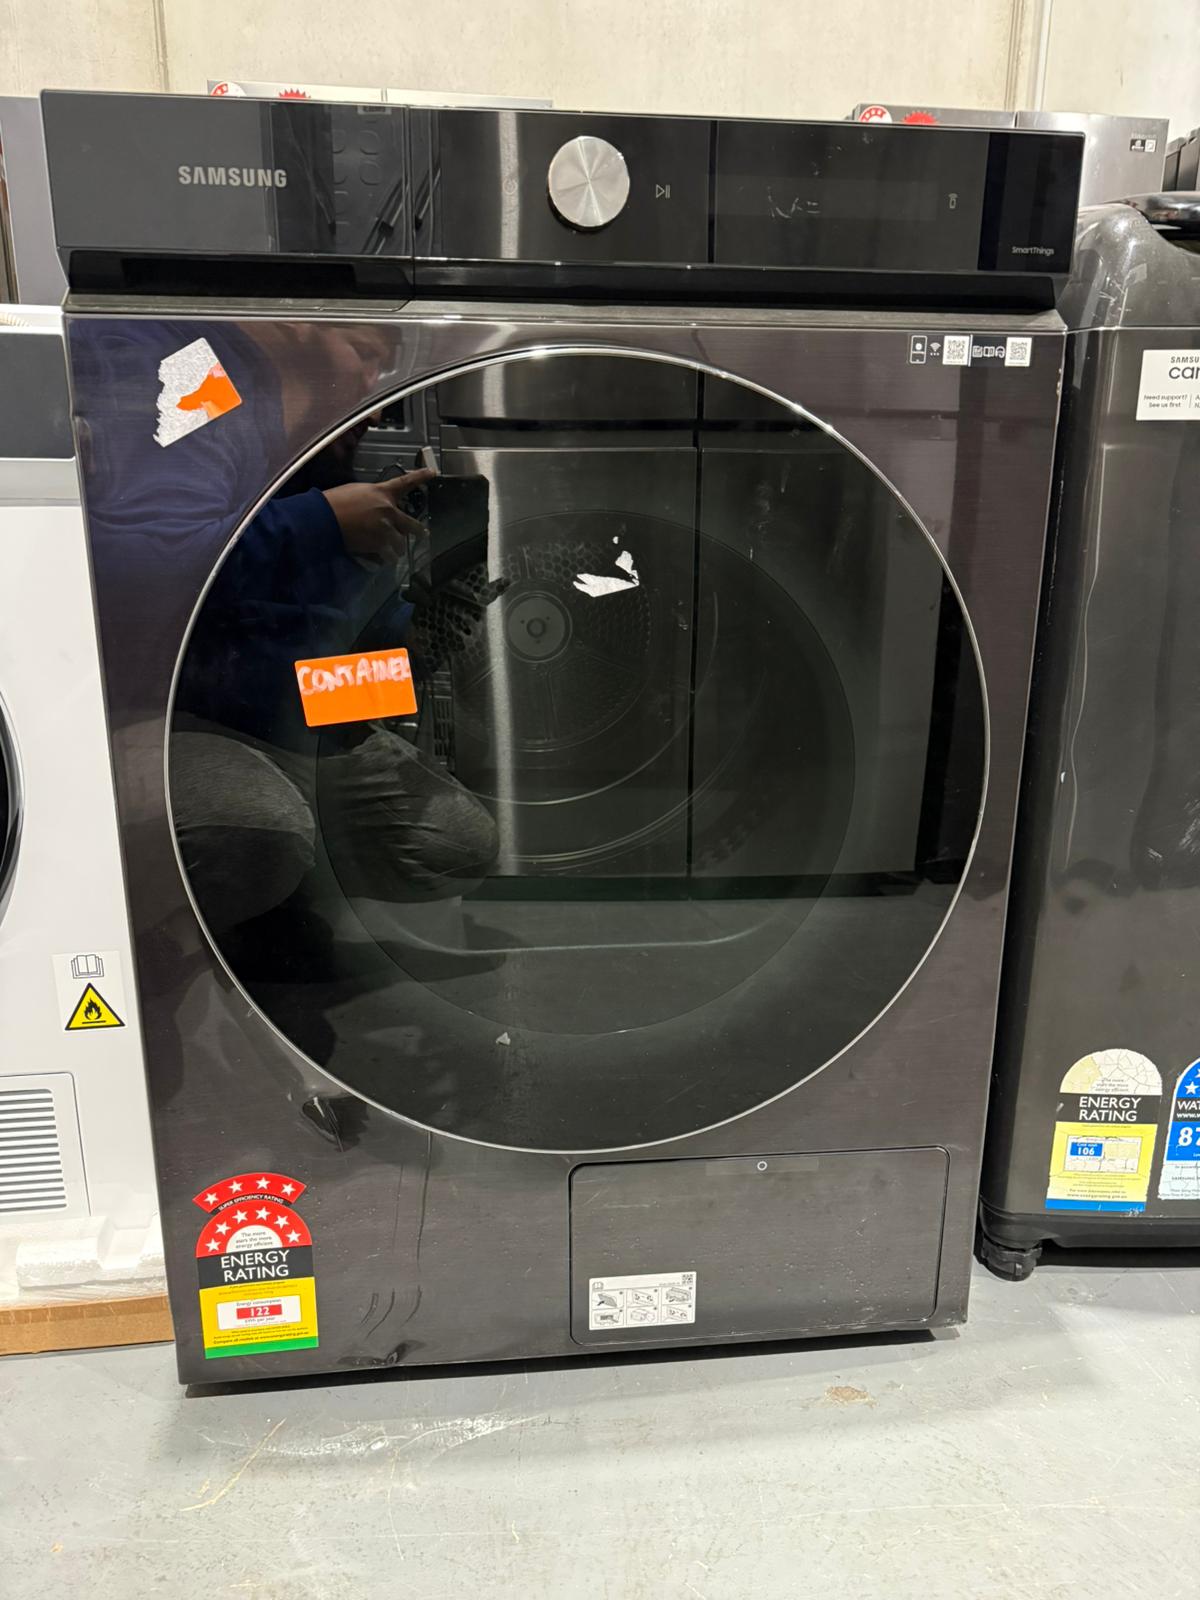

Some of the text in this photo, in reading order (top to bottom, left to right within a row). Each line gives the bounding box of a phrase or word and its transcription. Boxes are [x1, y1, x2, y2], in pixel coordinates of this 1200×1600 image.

[178, 165, 288, 188] SAMSUNG
[1011, 246, 1055, 257] SmartThings
[1079, 1096, 1142, 1110] ENERGY
[1079, 1109, 1138, 1122] RATING
[1077, 1147, 1095, 1155] 106
[218, 1199, 234, 1211] SUPER
[263, 1194, 285, 1204] RATING
[221, 1249, 290, 1269] ENERGY
[223, 1264, 289, 1282] RATING
[250, 1306, 270, 1317] 122
